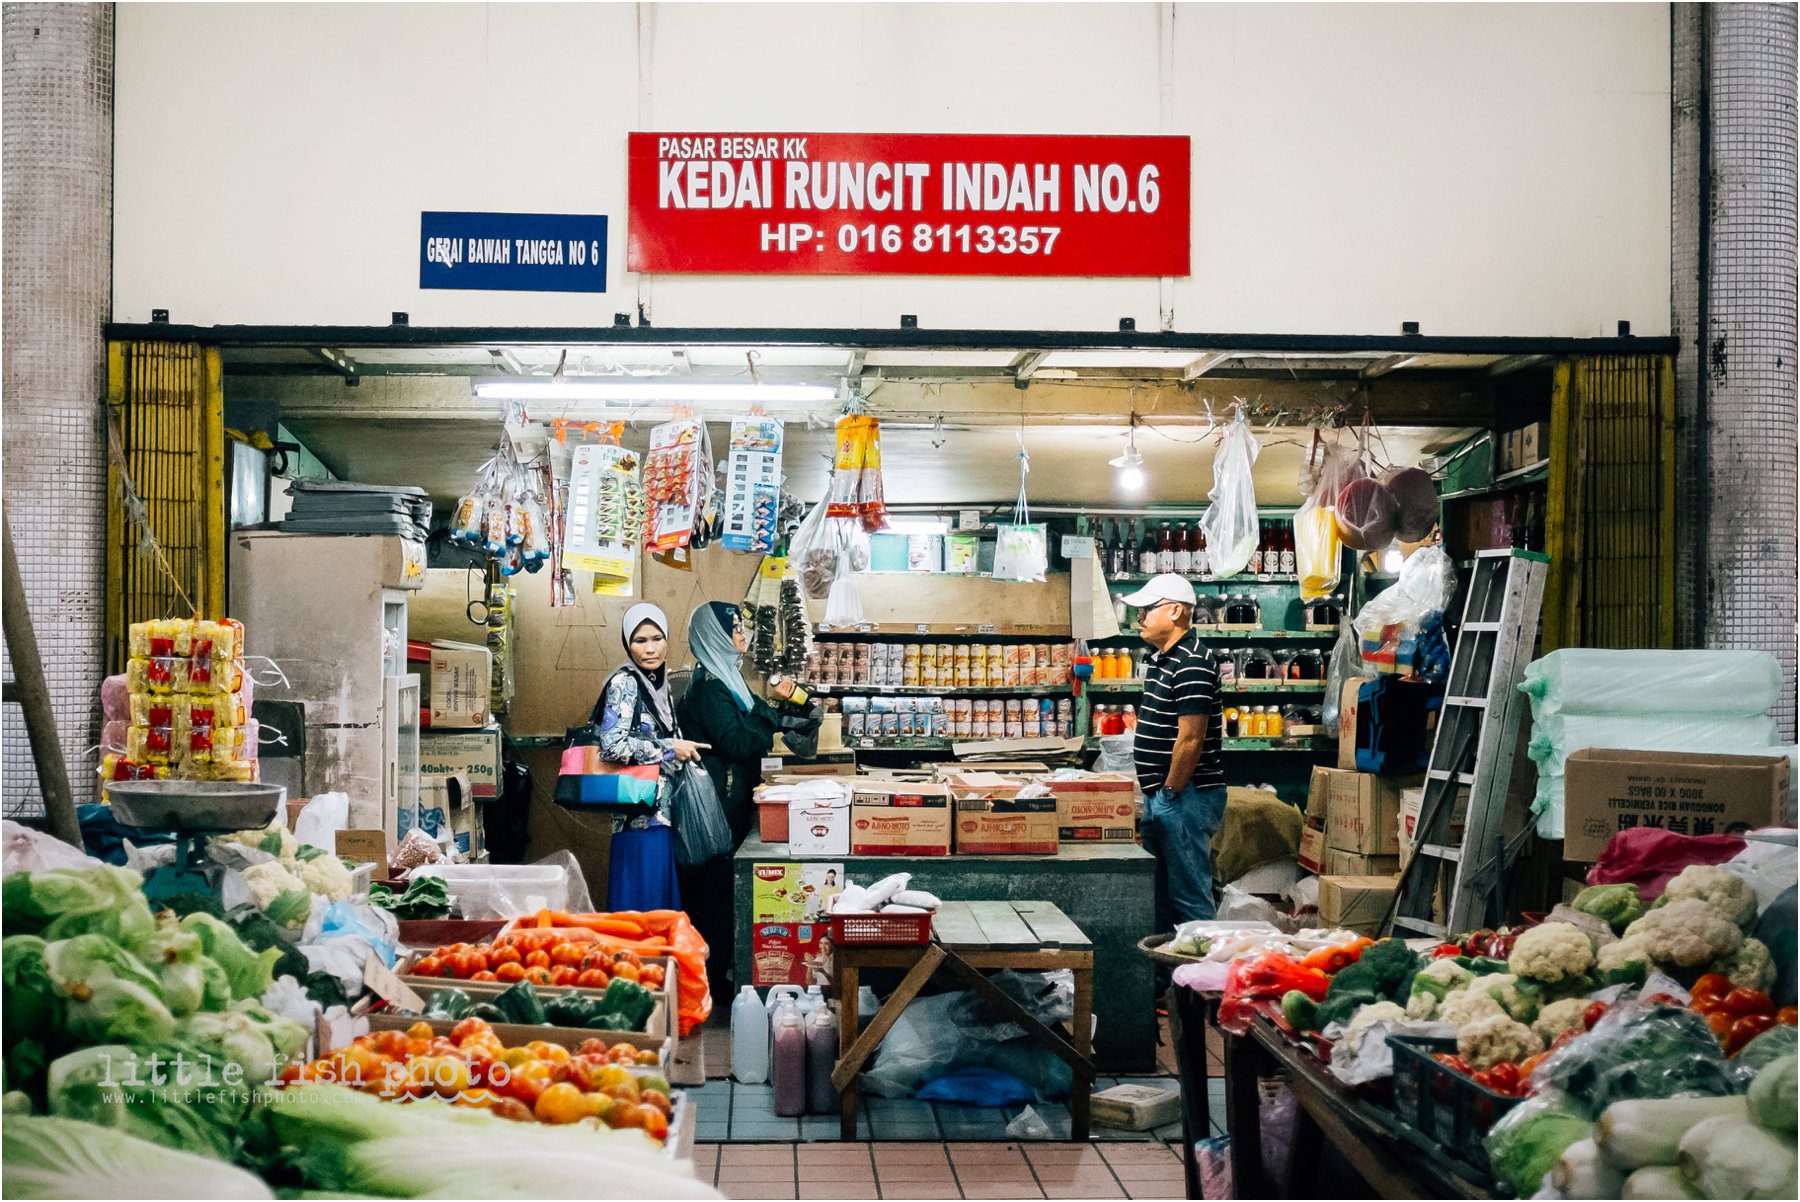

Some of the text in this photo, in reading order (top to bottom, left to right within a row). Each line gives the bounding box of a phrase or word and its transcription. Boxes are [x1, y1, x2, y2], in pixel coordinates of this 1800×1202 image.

[658, 137, 808, 159] PASAR BESAR KK
[658, 160, 1160, 213] KEDAI RUNCIT INDAH NO.6
[760, 223, 1061, 255] HP: 016 8113357
[426, 236, 599, 266] GERAI BAWAH TANGGA NO 6
[467, 764, 493, 776] 250g
[1628, 786, 1651, 797] BAGS
[1608, 798, 1725, 813] DONGGUAN RICE VERMICELLI
